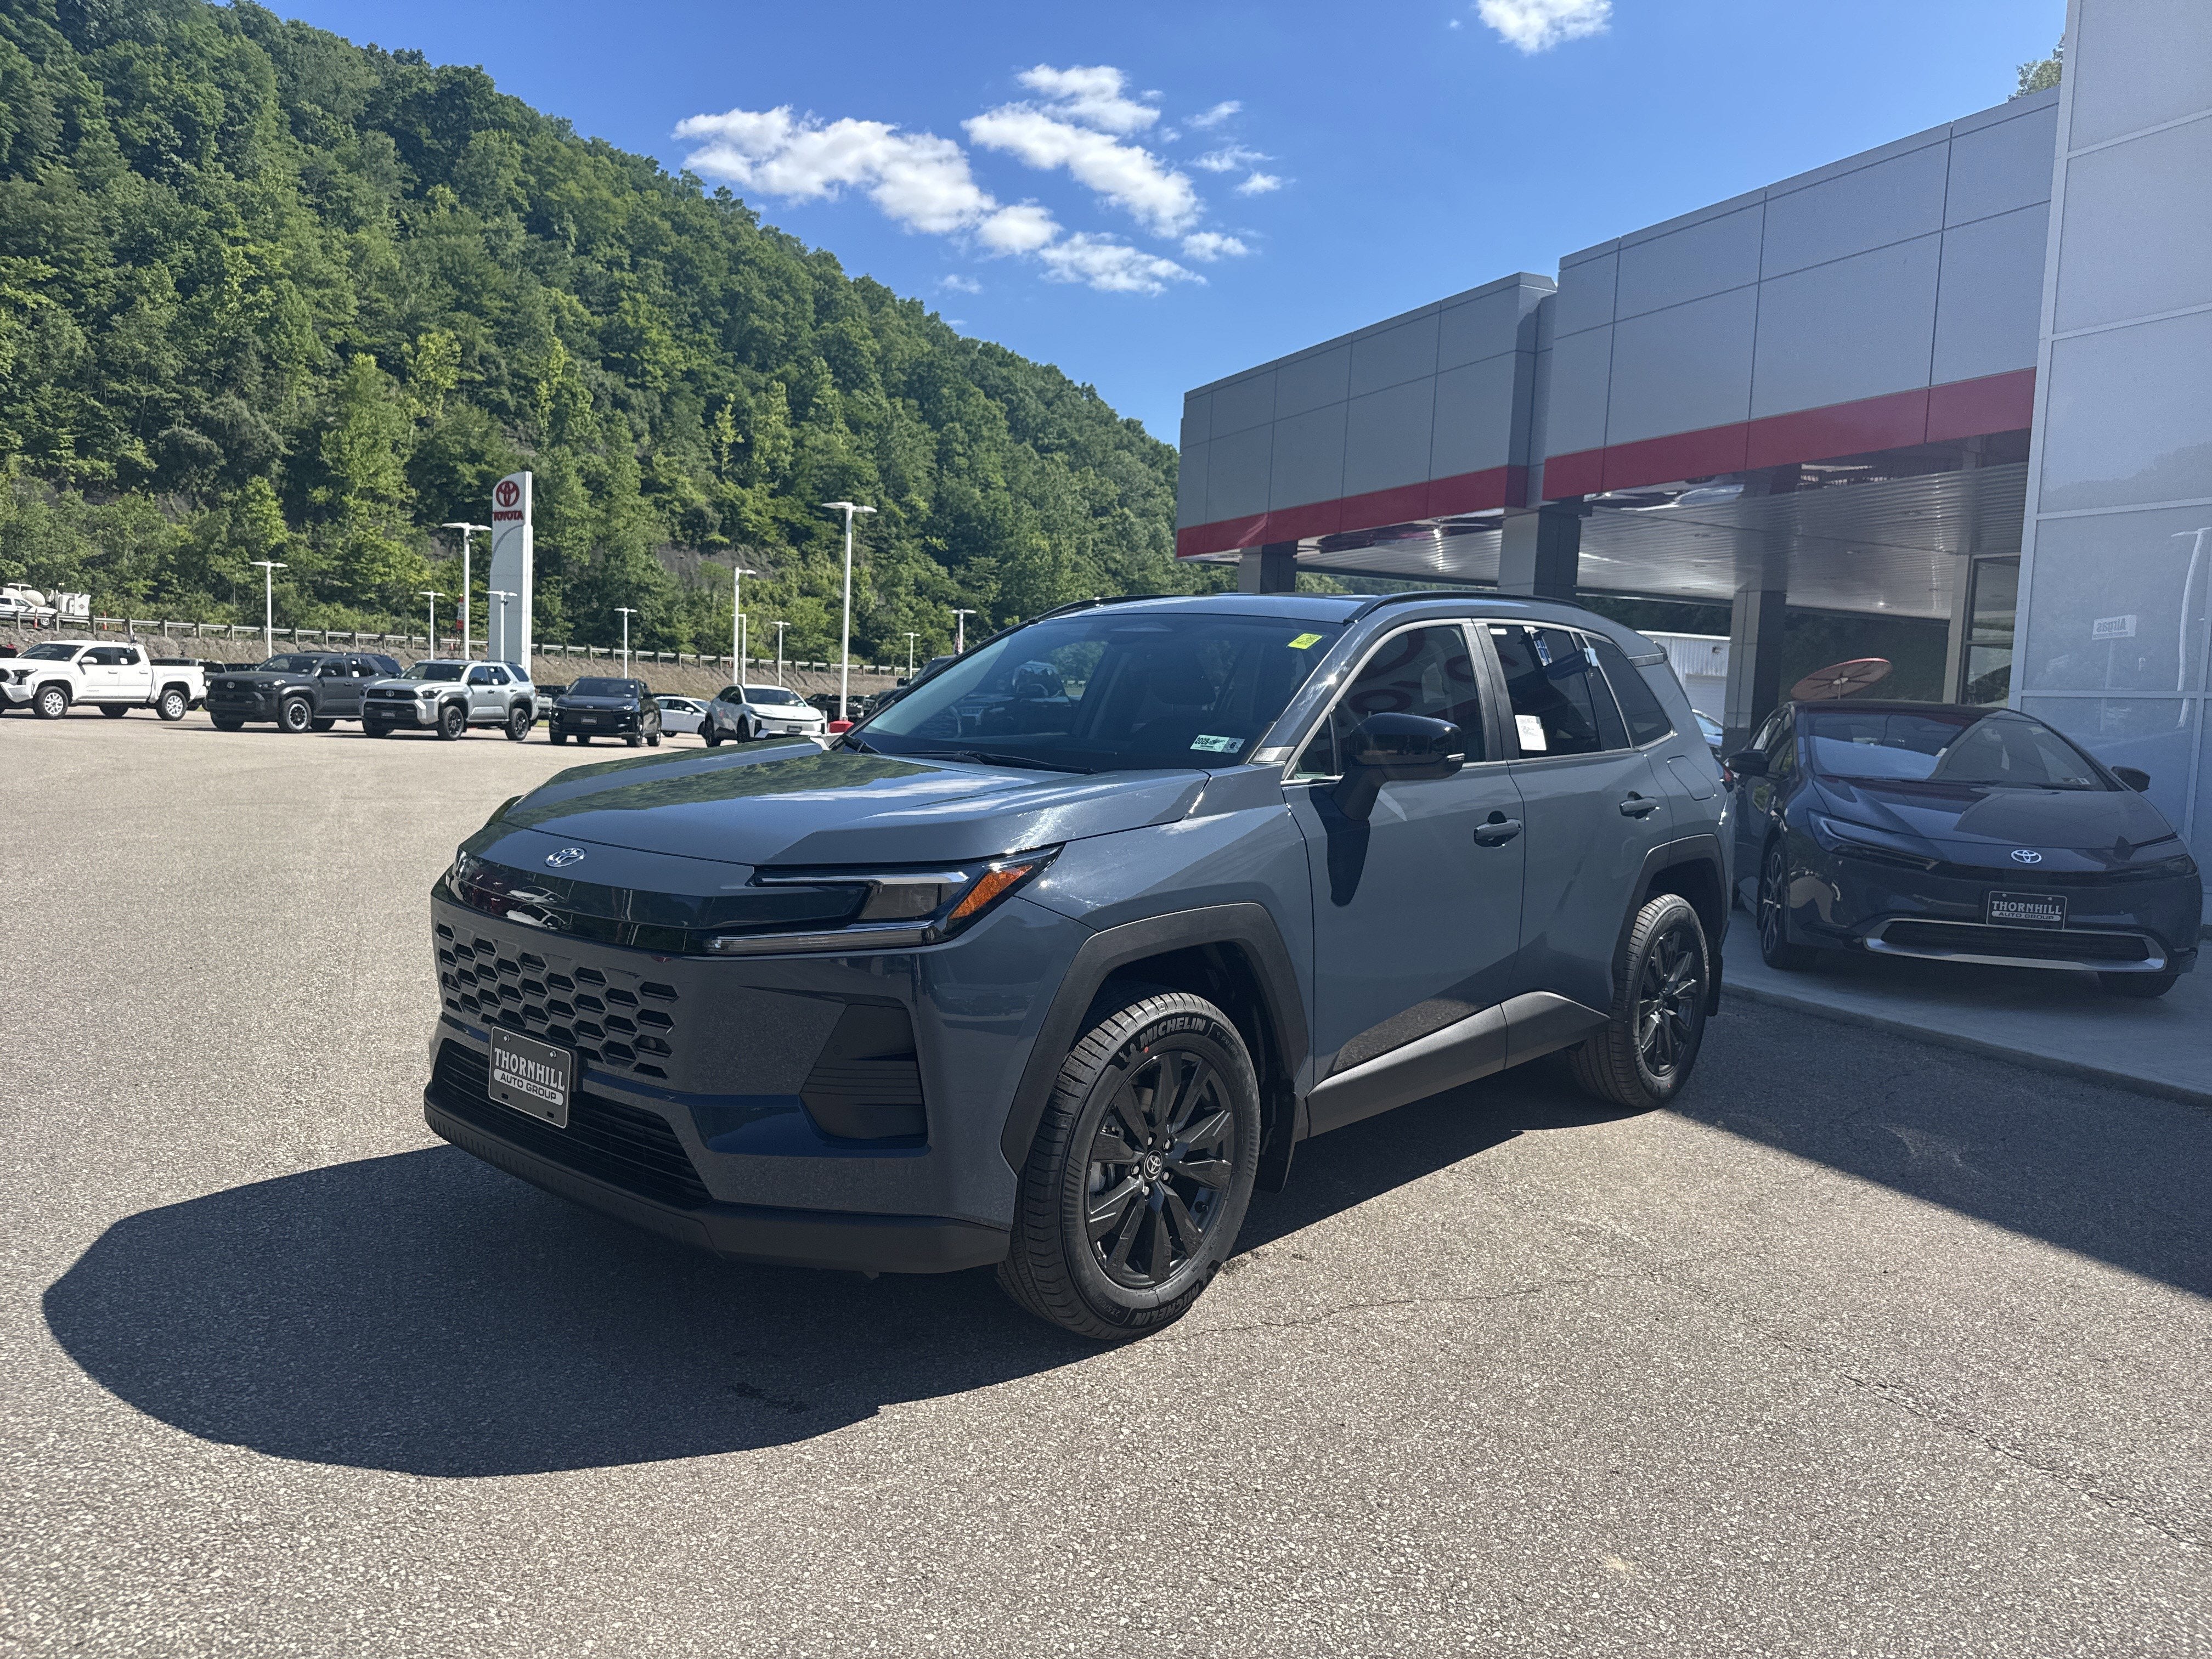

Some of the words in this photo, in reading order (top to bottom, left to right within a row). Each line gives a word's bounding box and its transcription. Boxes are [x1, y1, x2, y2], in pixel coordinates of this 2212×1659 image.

[493, 510, 524, 521] TOYOTA
[1992, 901, 2062, 915] THORNHILL
[1139, 1017, 1206, 1049] MICHELIN
[494, 1047, 565, 1092] THORNHILL
[500, 1073, 523, 1088] AUTO
[526, 1082, 556, 1101] GROUP
[1131, 1283, 1200, 1325] MICHELIN
